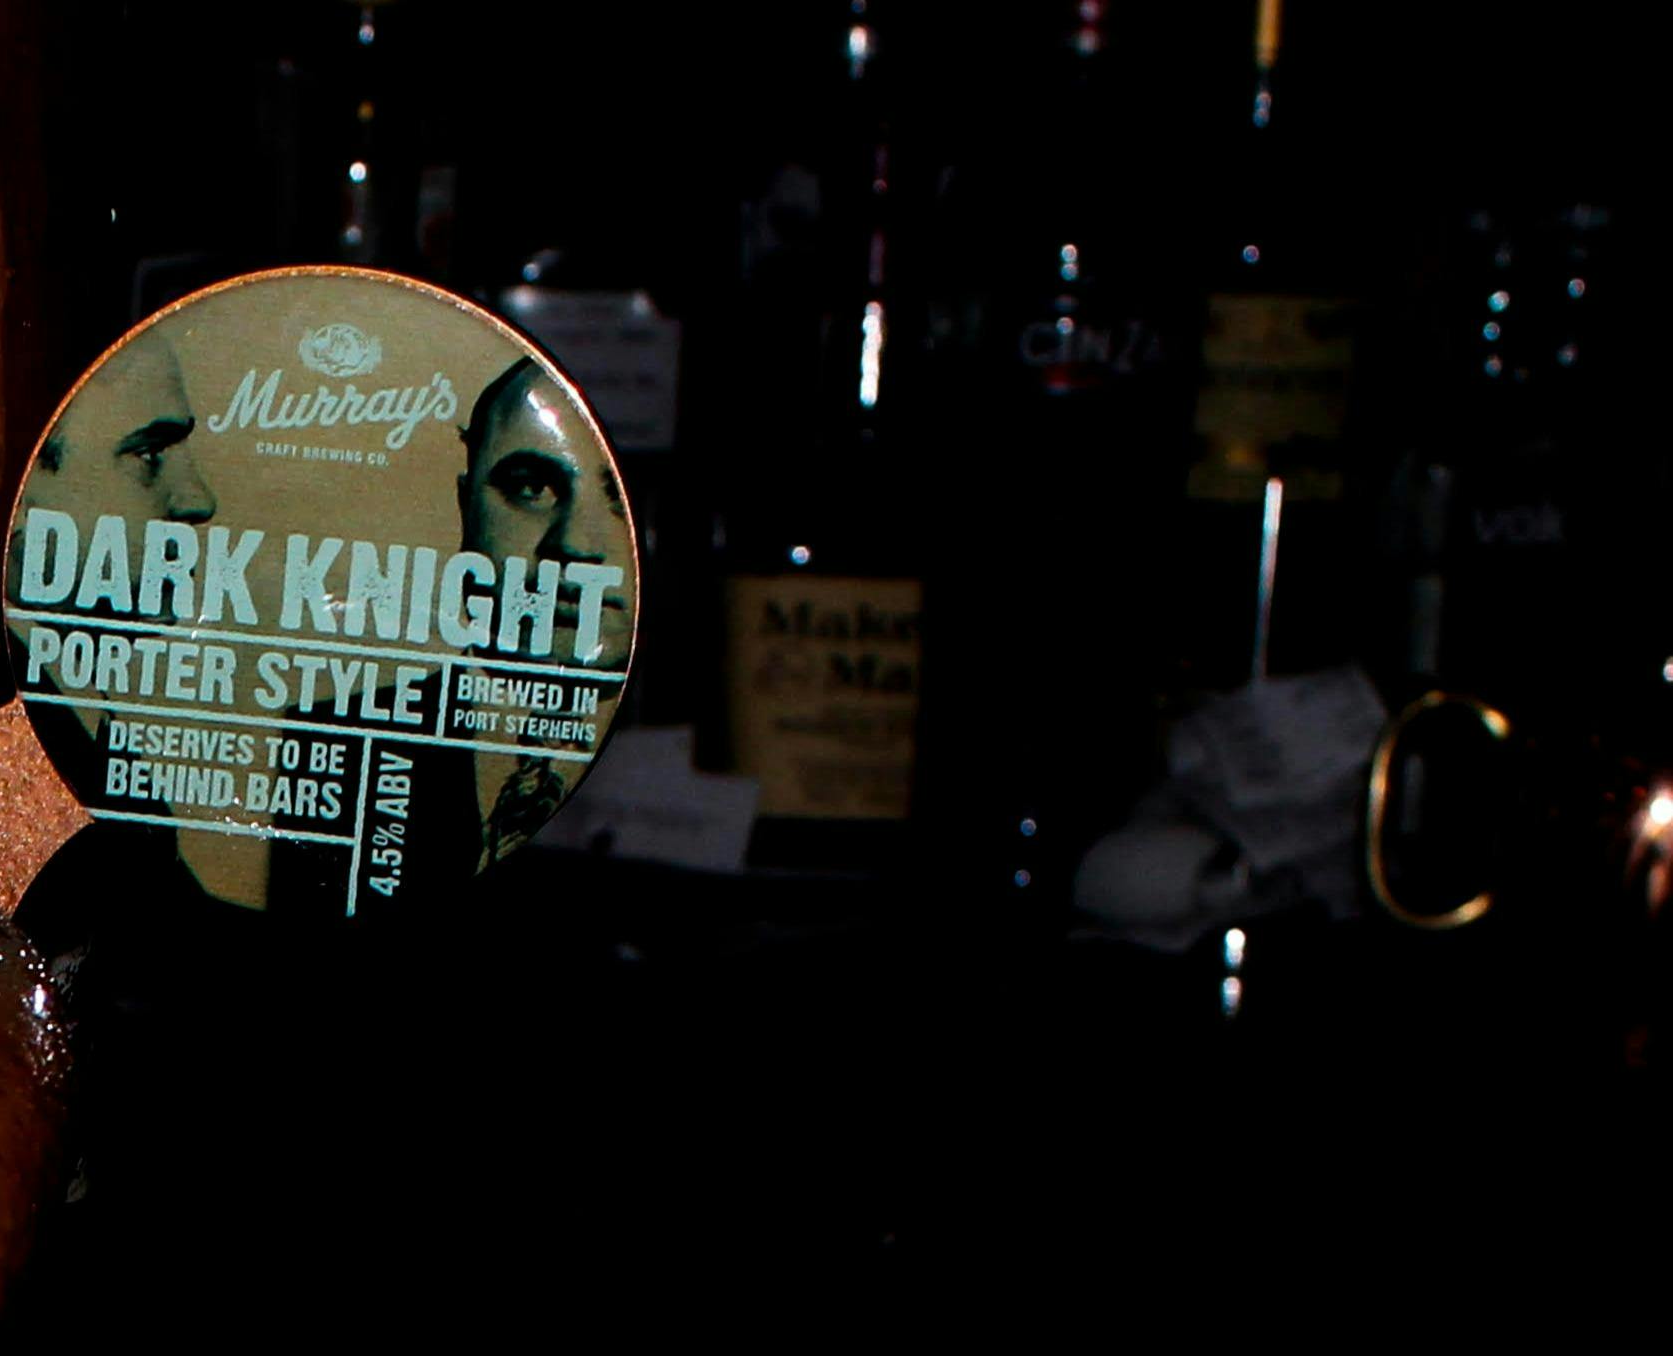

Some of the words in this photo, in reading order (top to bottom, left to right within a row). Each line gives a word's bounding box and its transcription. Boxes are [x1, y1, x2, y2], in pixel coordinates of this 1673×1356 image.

[207, 368, 458, 450] Murray's
[256, 441, 296, 458] CRAFT
[303, 445, 363, 463] BREWING
[19, 507, 264, 626] DARK
[280, 535, 623, 664] KNIGHT
[26, 626, 239, 705] PORTER
[255, 654, 426, 724] STYLE
[457, 675, 561, 711] BREWED
[570, 683, 600, 716] IN
[108, 721, 255, 765] DESERVES
[264, 737, 300, 770] TO
[308, 742, 348, 776] BE
[453, 709, 498, 732] PORT
[504, 714, 597, 743] STEPHENS
[105, 760, 232, 807] BEHIND
[245, 775, 343, 818] BARS
[375, 752, 415, 812] ABV
[369, 822, 408, 896] 4.5%
